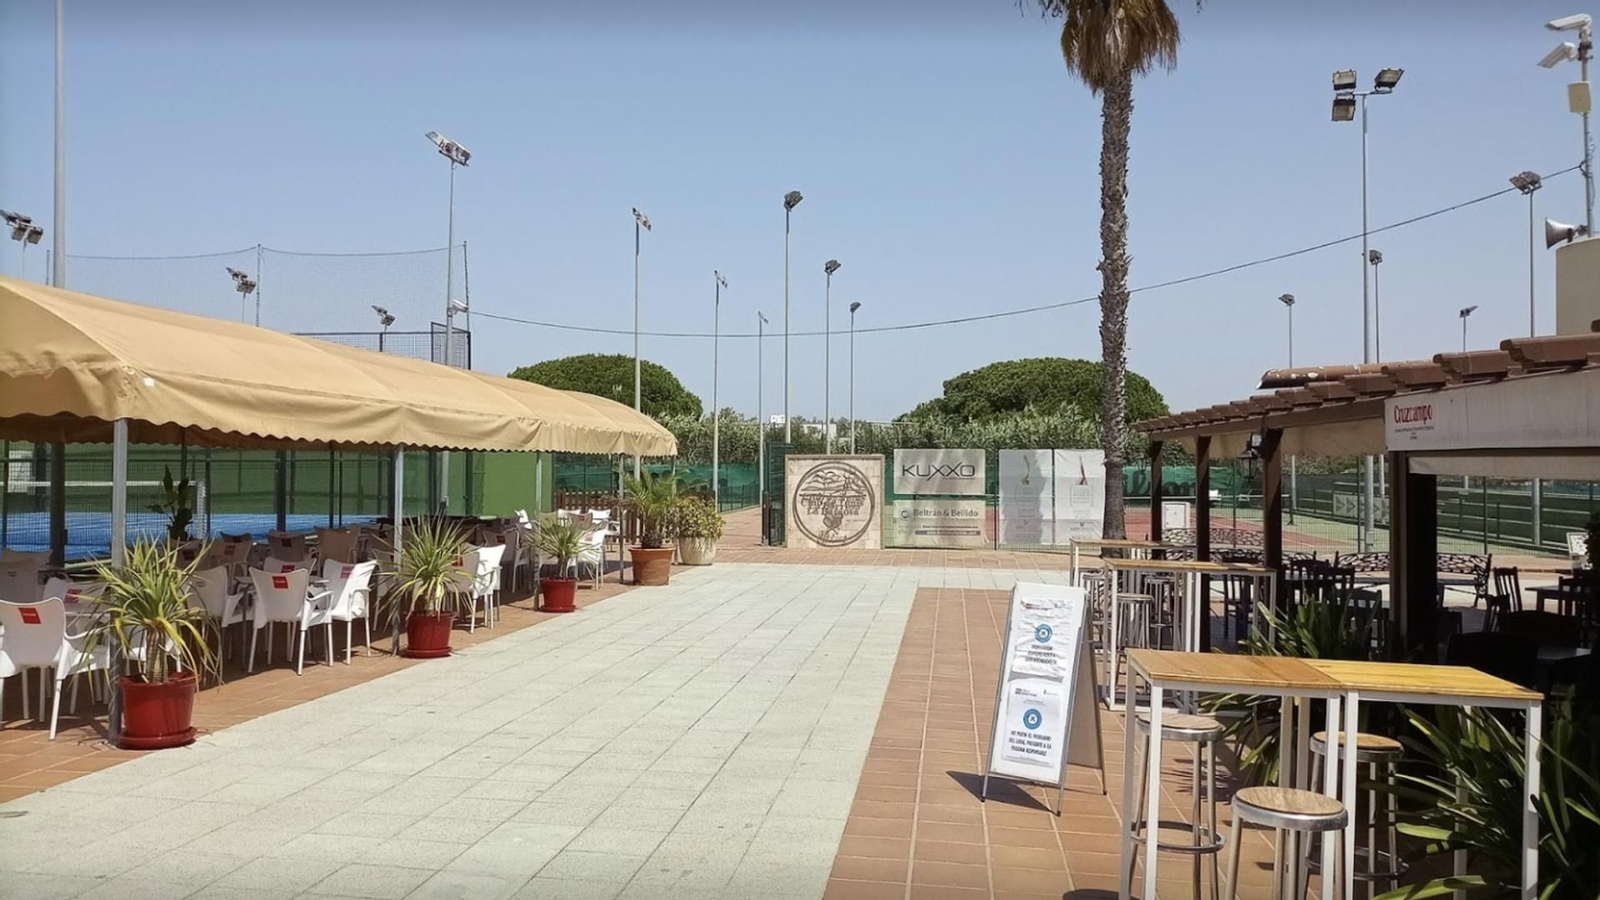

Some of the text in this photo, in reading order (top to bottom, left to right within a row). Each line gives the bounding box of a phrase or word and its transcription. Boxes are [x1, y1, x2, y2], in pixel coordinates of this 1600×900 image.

[1394, 404, 1433, 424] Cruzcampo
[902, 462, 975, 481] KUXXO
[913, 508, 979, 517] Beltrán & Bellido
